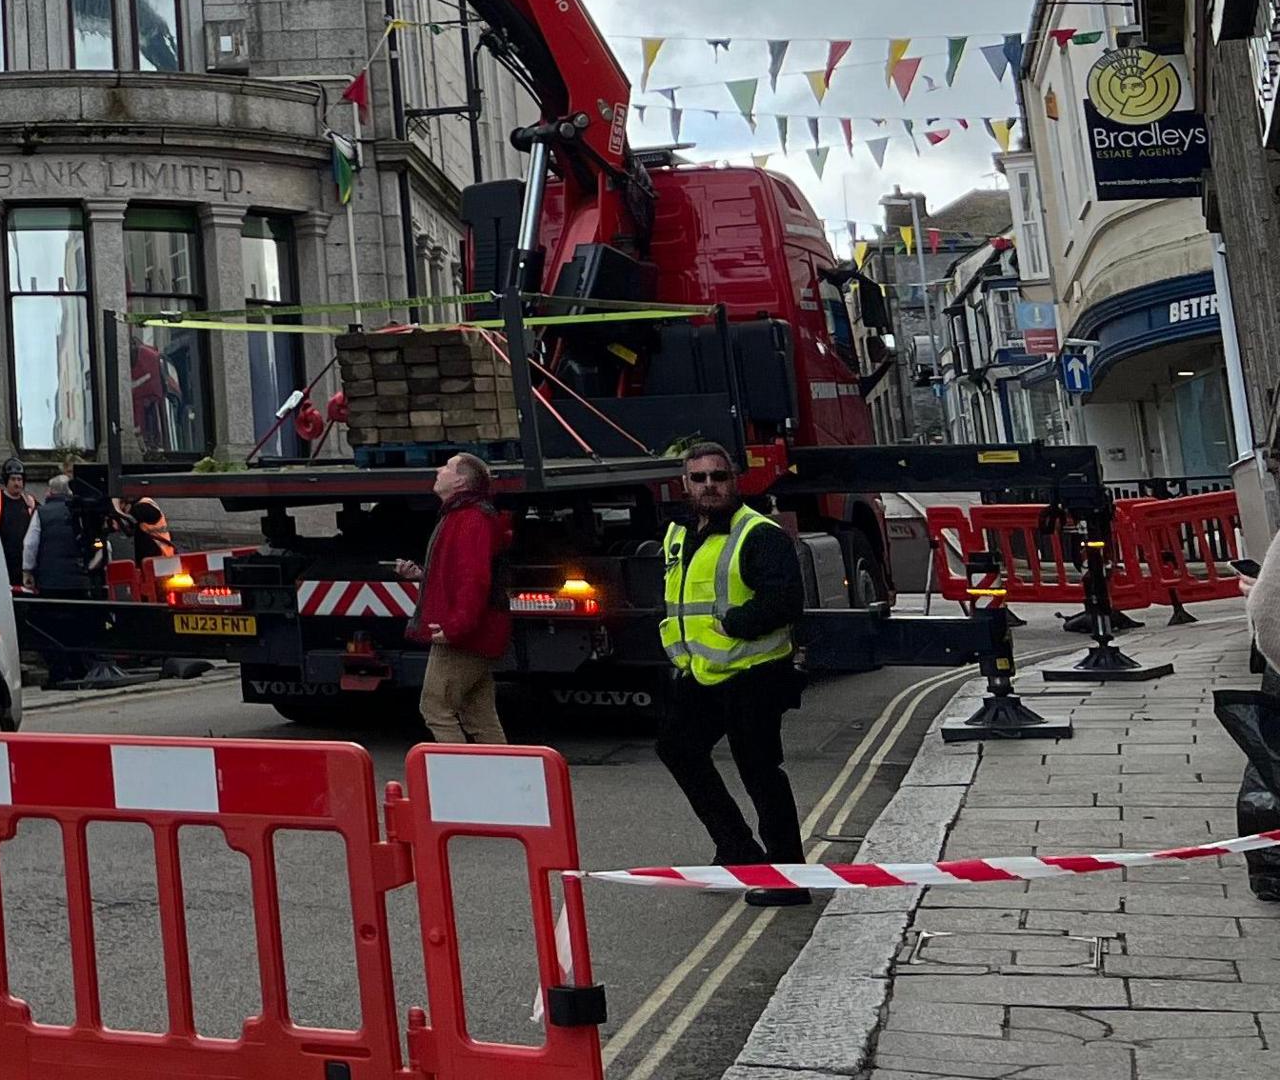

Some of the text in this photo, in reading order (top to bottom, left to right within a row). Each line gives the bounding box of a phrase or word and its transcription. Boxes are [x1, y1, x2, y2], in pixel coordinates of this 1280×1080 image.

[610, 108, 626, 151] FASSI
[1093, 123, 1206, 151] Bradleys
[1096, 147, 1183, 159] ESTATE AGENTS
[180, 617, 249, 632] NJ23 FNT
[250, 680, 338, 696] VOLVO
[551, 690, 652, 706] VOLVO
